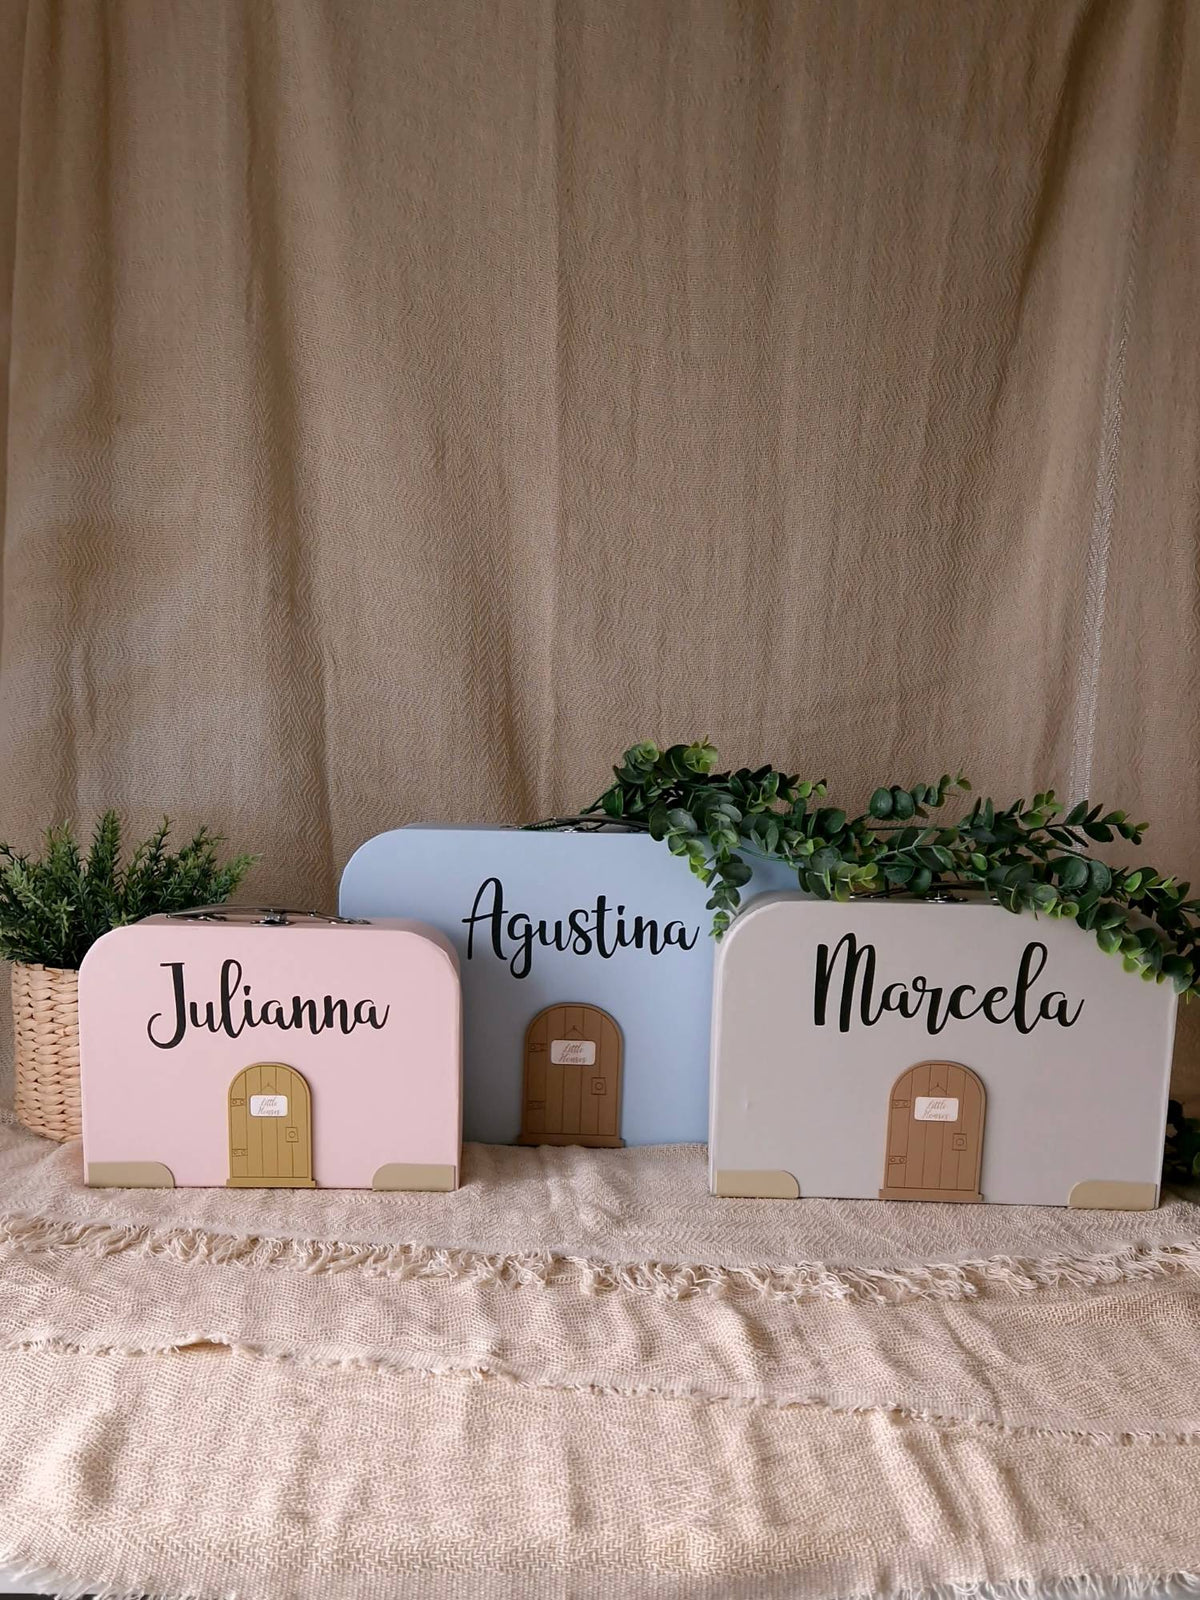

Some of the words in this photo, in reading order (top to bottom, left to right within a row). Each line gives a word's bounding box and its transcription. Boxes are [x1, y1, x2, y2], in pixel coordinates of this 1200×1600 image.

[462, 878, 700, 980] Agustina
[147, 959, 390, 1049] Julianna
[814, 932, 1085, 1035] Marcela
